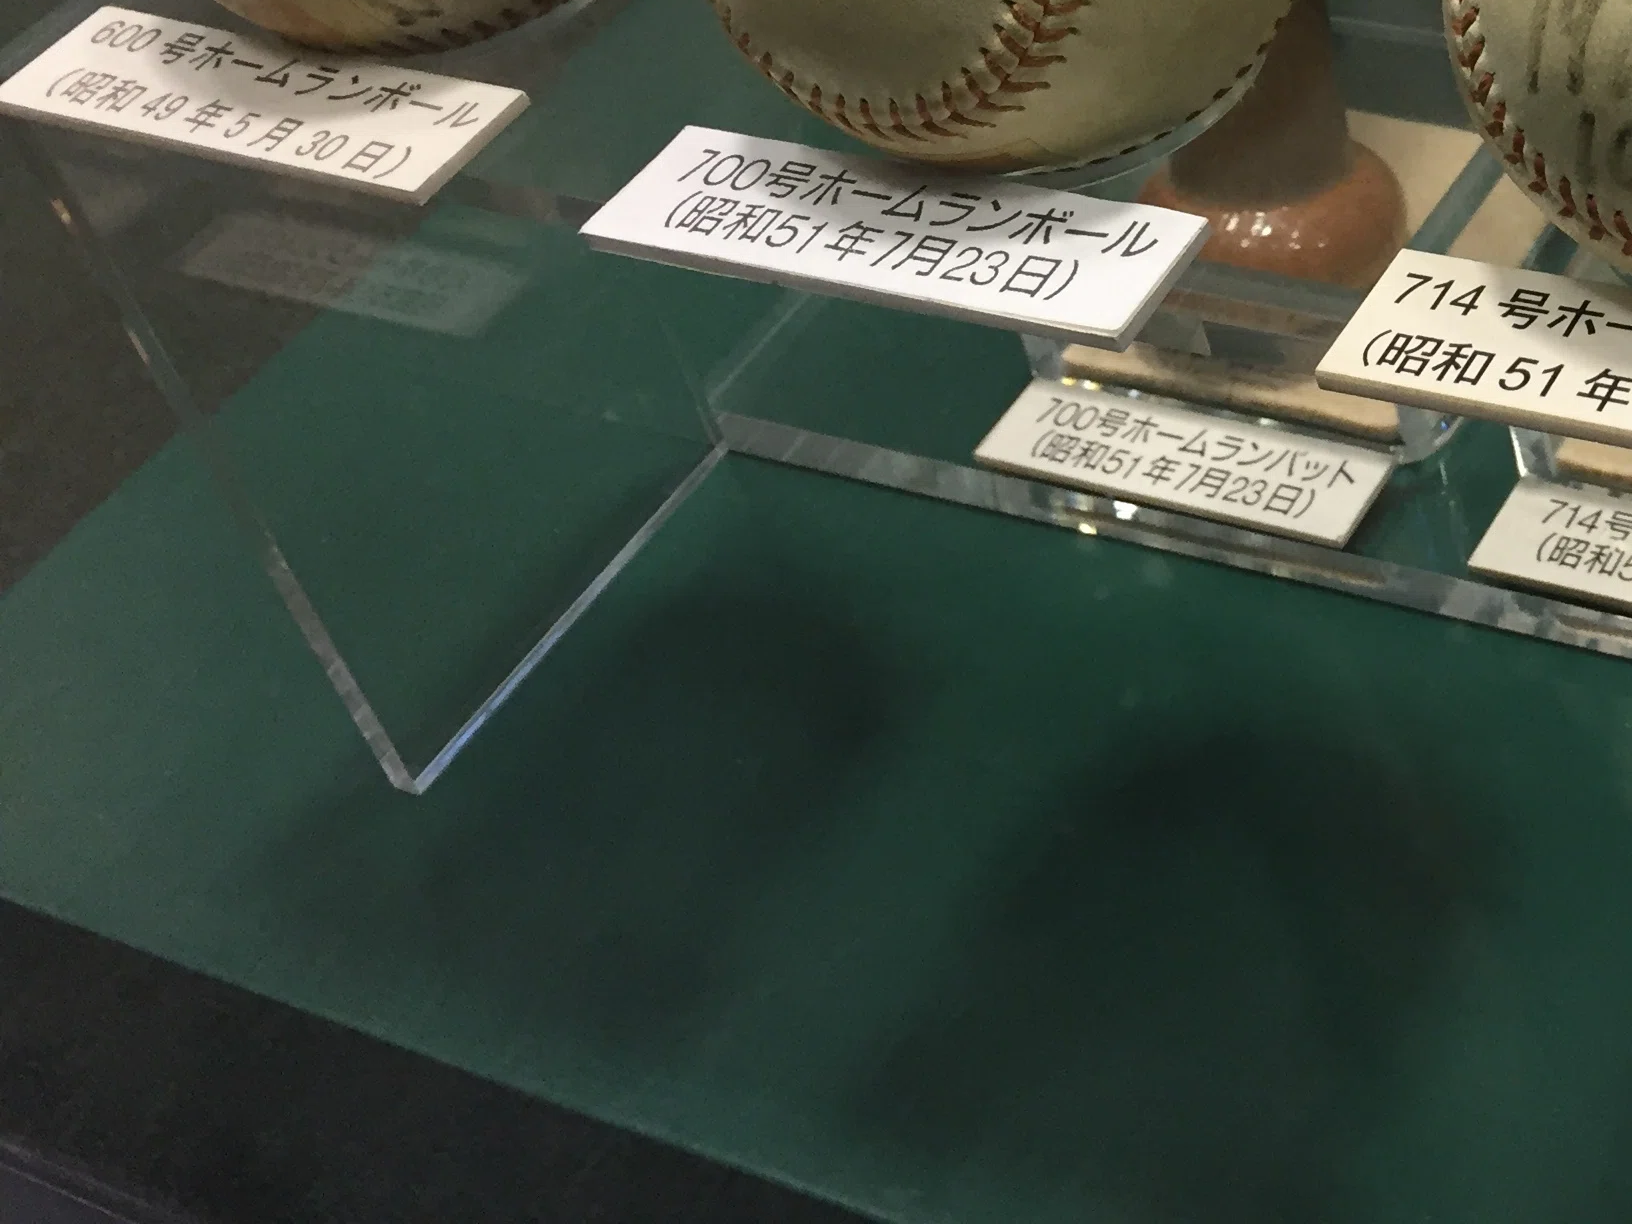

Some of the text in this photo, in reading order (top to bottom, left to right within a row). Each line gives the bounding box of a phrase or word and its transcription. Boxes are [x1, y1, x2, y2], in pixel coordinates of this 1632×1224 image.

[664, 199, 1080, 302] (昭和51年7月23日)
[678, 148, 1159, 260] 700号ホームランボール
[1029, 439, 1317, 517] (昭和51年7月23日)
[1035, 398, 1357, 487] 700号ホームランバット
